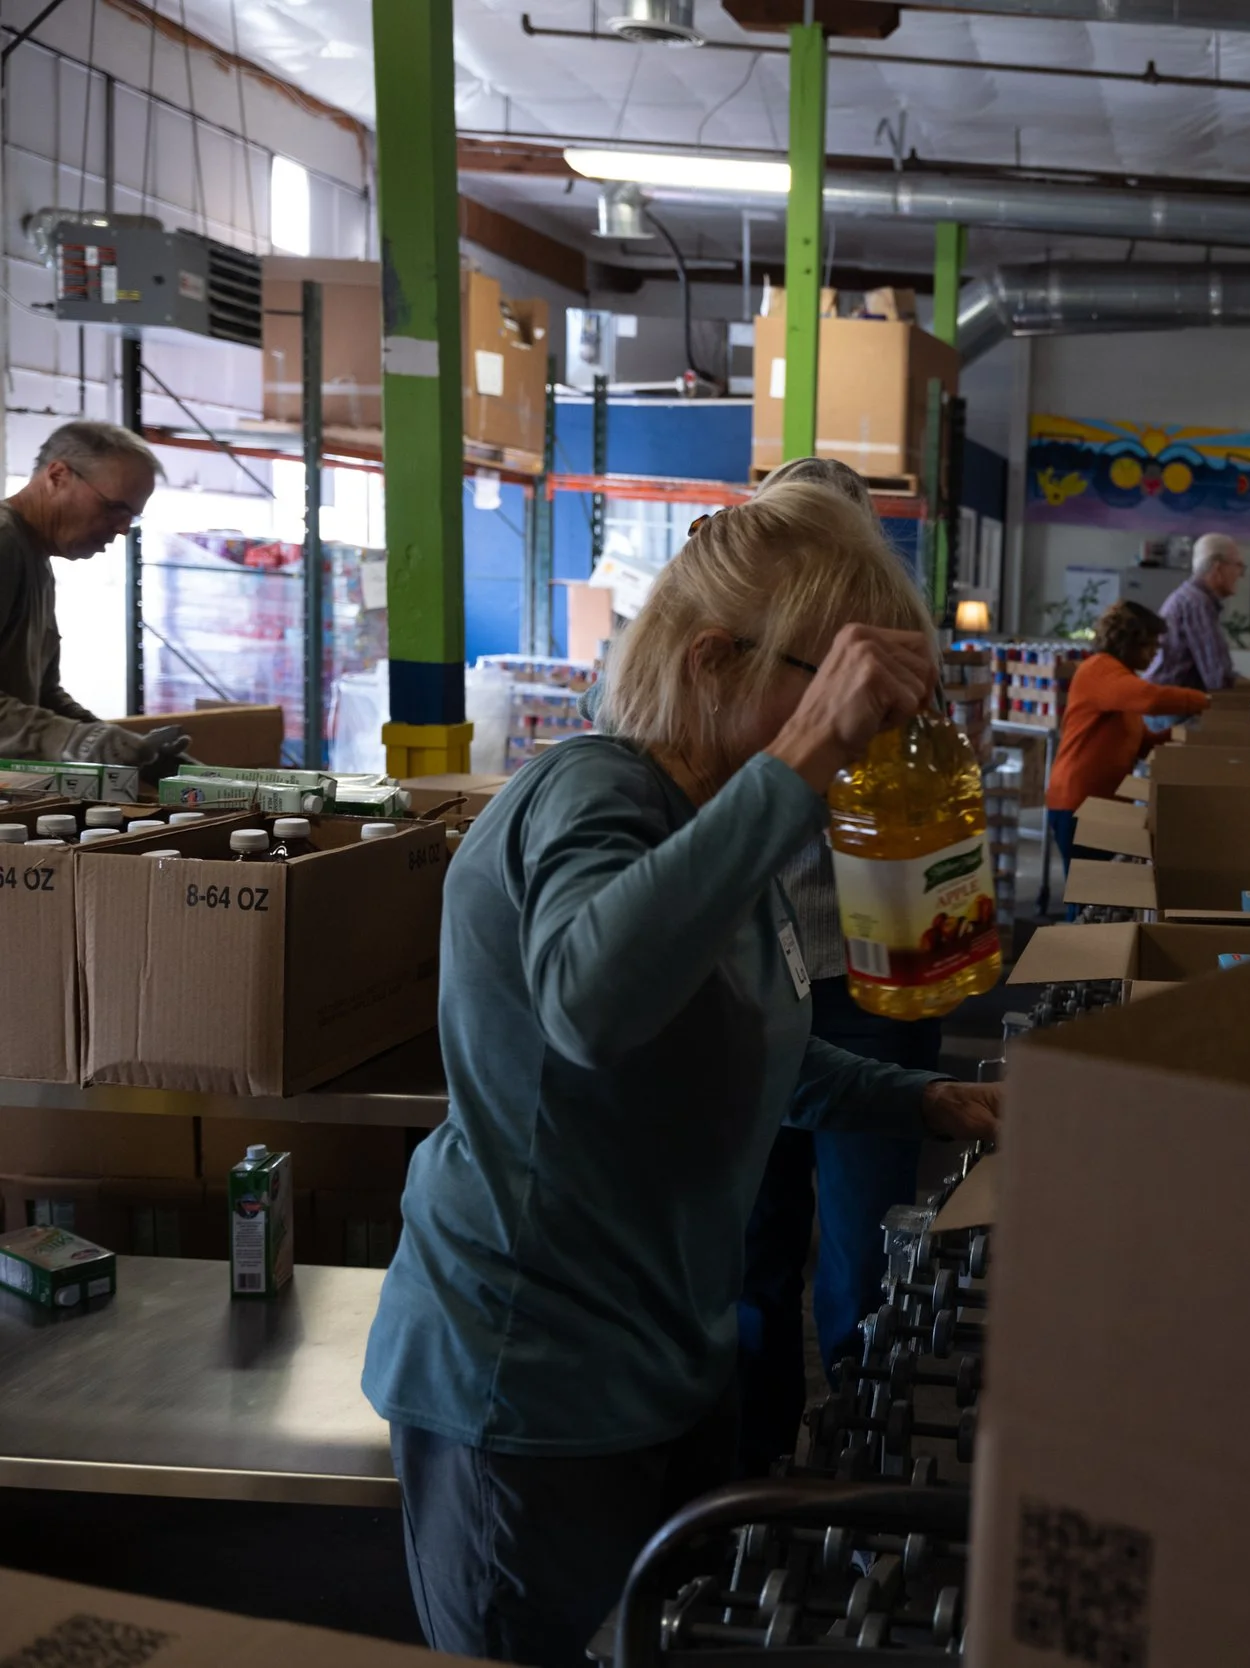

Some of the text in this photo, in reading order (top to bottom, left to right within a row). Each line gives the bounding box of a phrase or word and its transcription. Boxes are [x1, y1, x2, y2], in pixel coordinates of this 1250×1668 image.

[24, 868, 55, 891] OZ
[186, 884, 269, 911] 8-64 OZ
